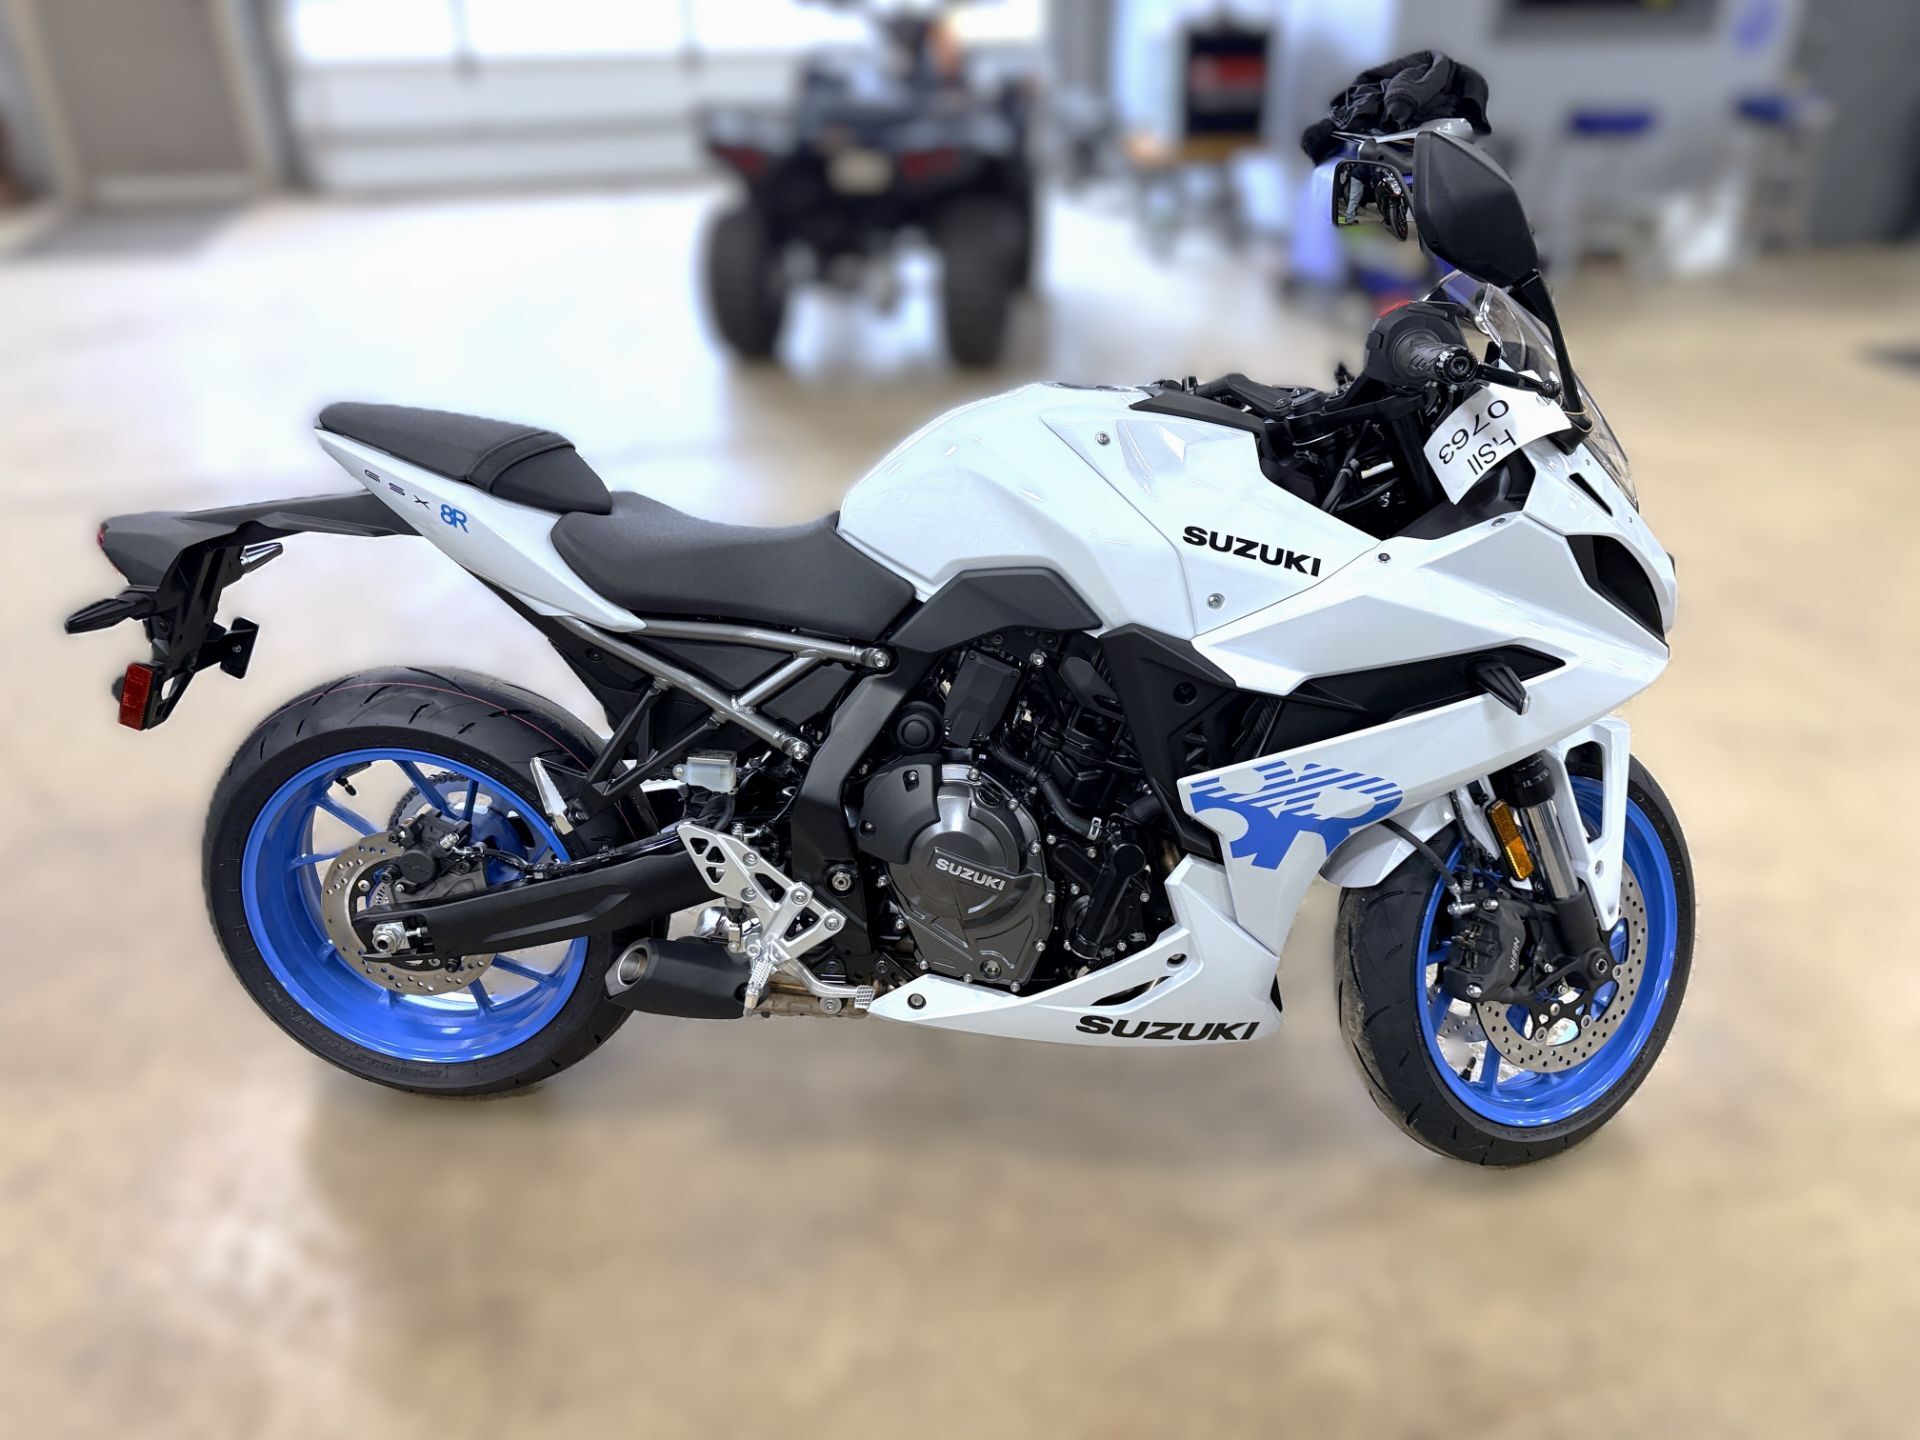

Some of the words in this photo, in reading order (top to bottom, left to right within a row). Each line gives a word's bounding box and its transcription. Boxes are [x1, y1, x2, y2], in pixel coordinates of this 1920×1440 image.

[1438, 399, 1510, 465] 0763
[440, 503, 469, 534] 8R
[1182, 525, 1322, 577] SUZUKI
[935, 857, 1007, 891] SUZUKI
[1075, 1015, 1261, 1041] SUZUKI
